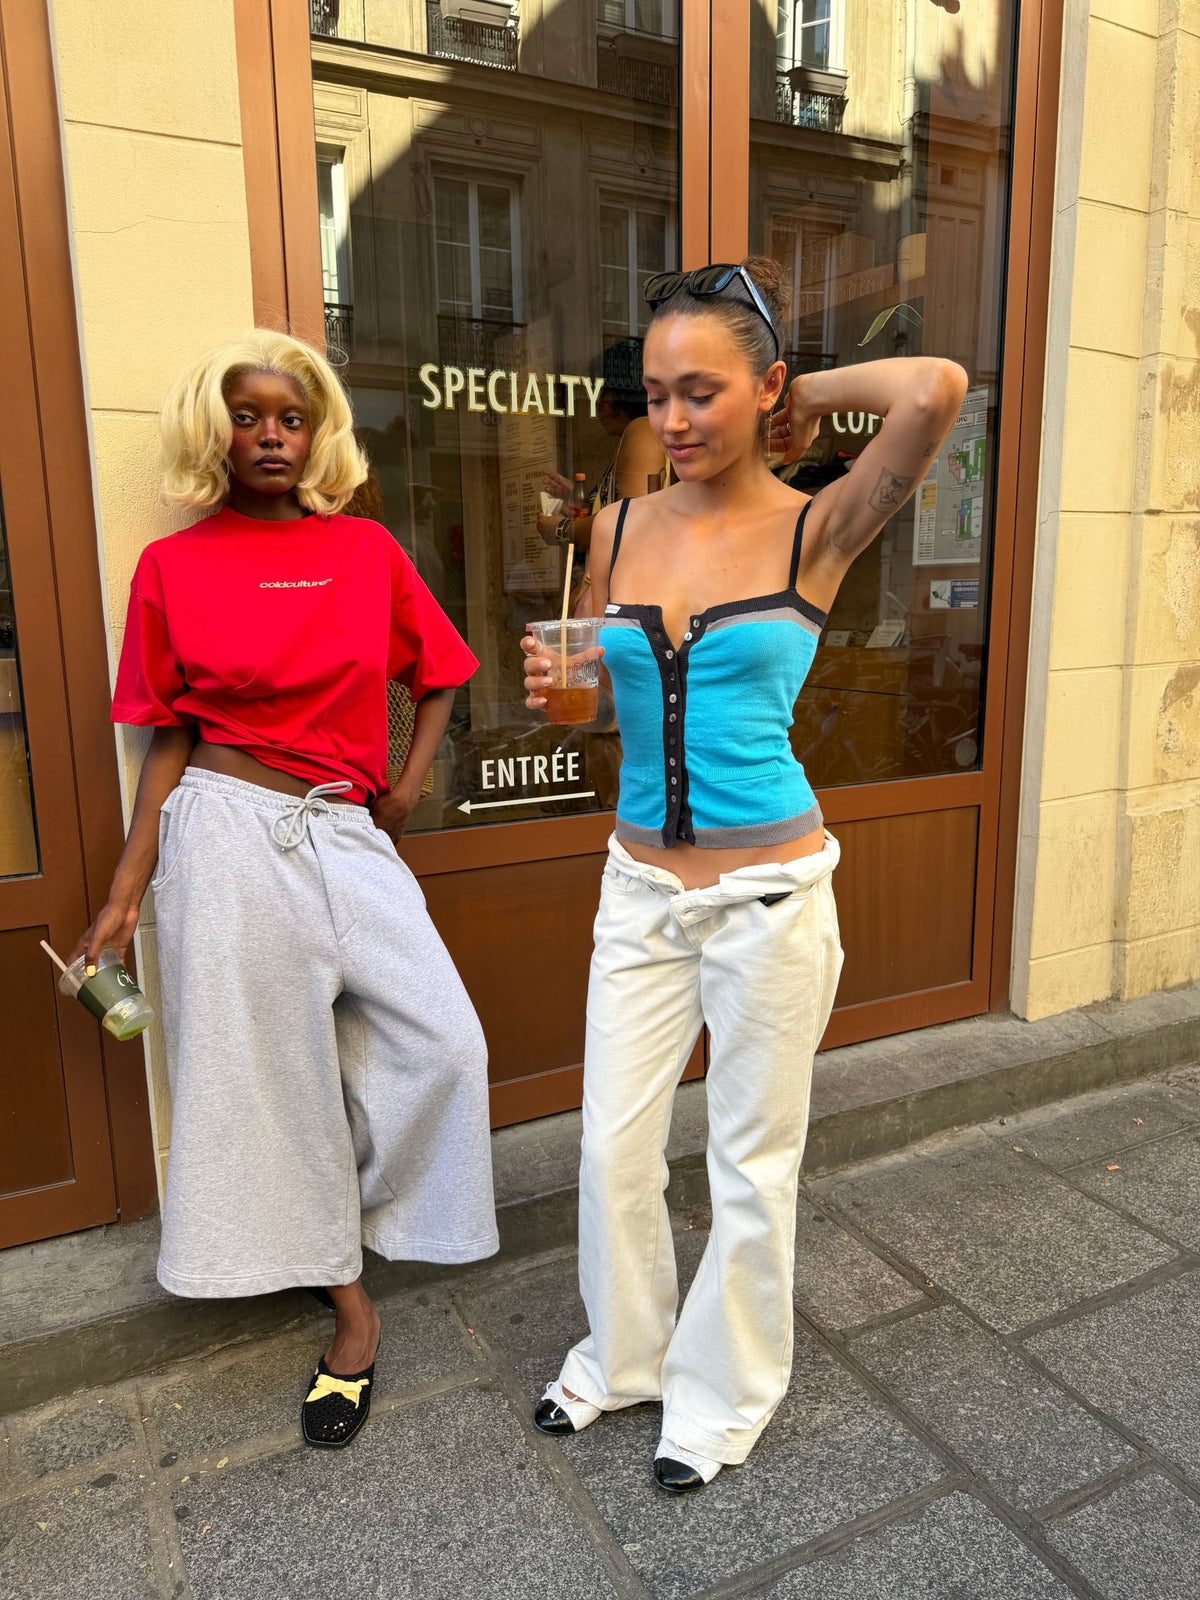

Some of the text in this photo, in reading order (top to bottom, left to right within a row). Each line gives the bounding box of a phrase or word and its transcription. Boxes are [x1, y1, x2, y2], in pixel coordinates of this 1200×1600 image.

[419, 363, 605, 417] SPECIALTY
[259, 578, 330, 588] coldculture
[482, 747, 580, 789] ENTRÉE
